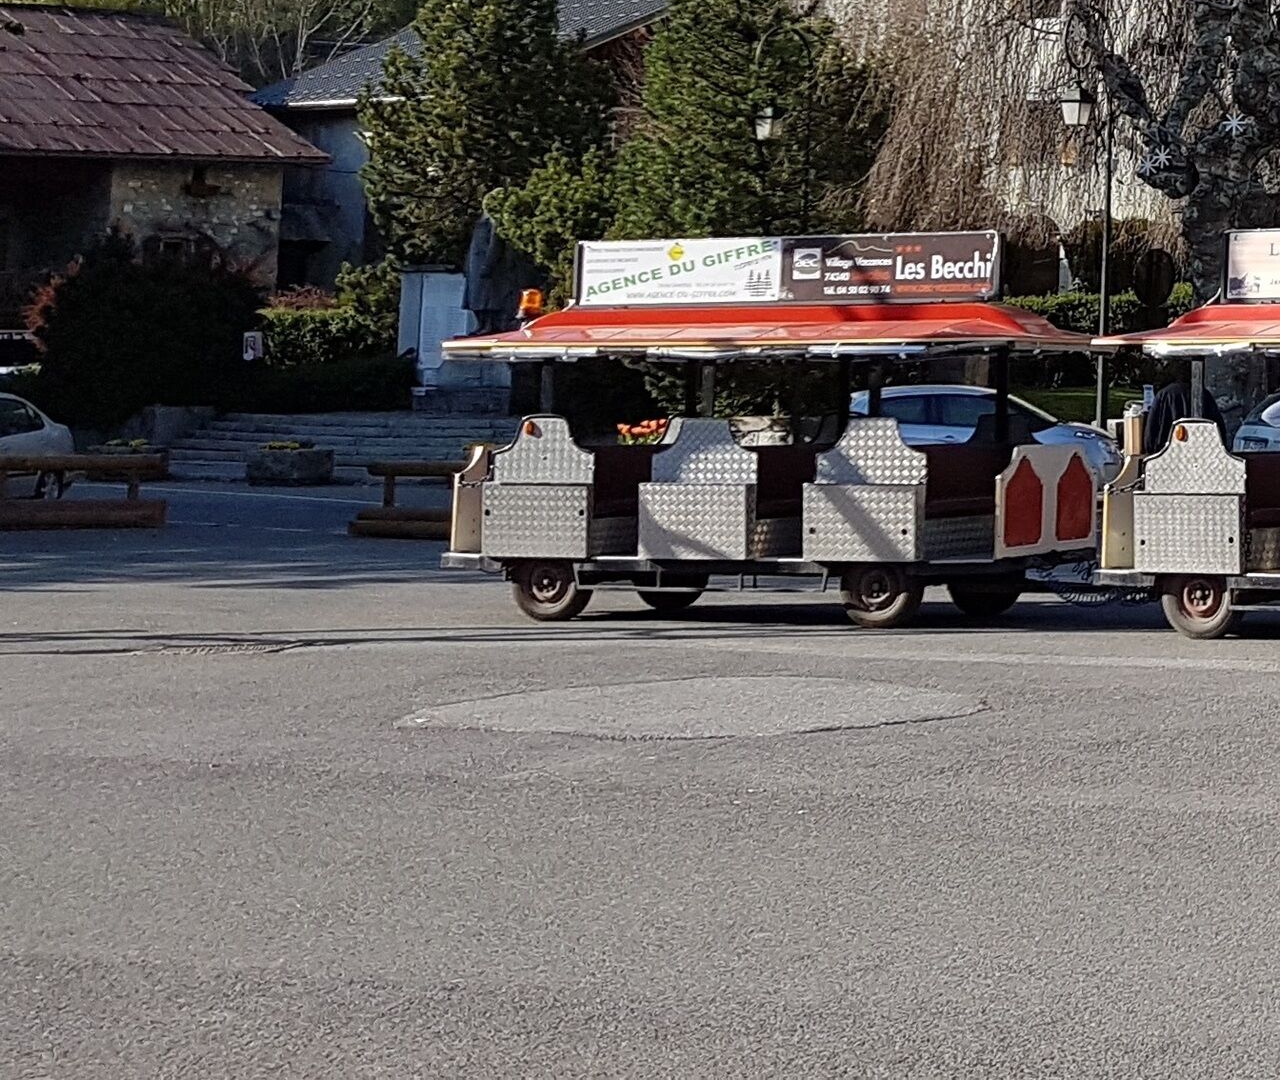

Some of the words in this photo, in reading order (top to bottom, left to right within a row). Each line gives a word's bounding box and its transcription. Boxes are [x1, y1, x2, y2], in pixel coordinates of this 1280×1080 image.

[586, 267, 663, 298] AGENCE
[669, 260, 696, 277] DU
[702, 240, 775, 267] GIFFRE
[895, 255, 926, 280] Les
[930, 249, 992, 279] Becchi
